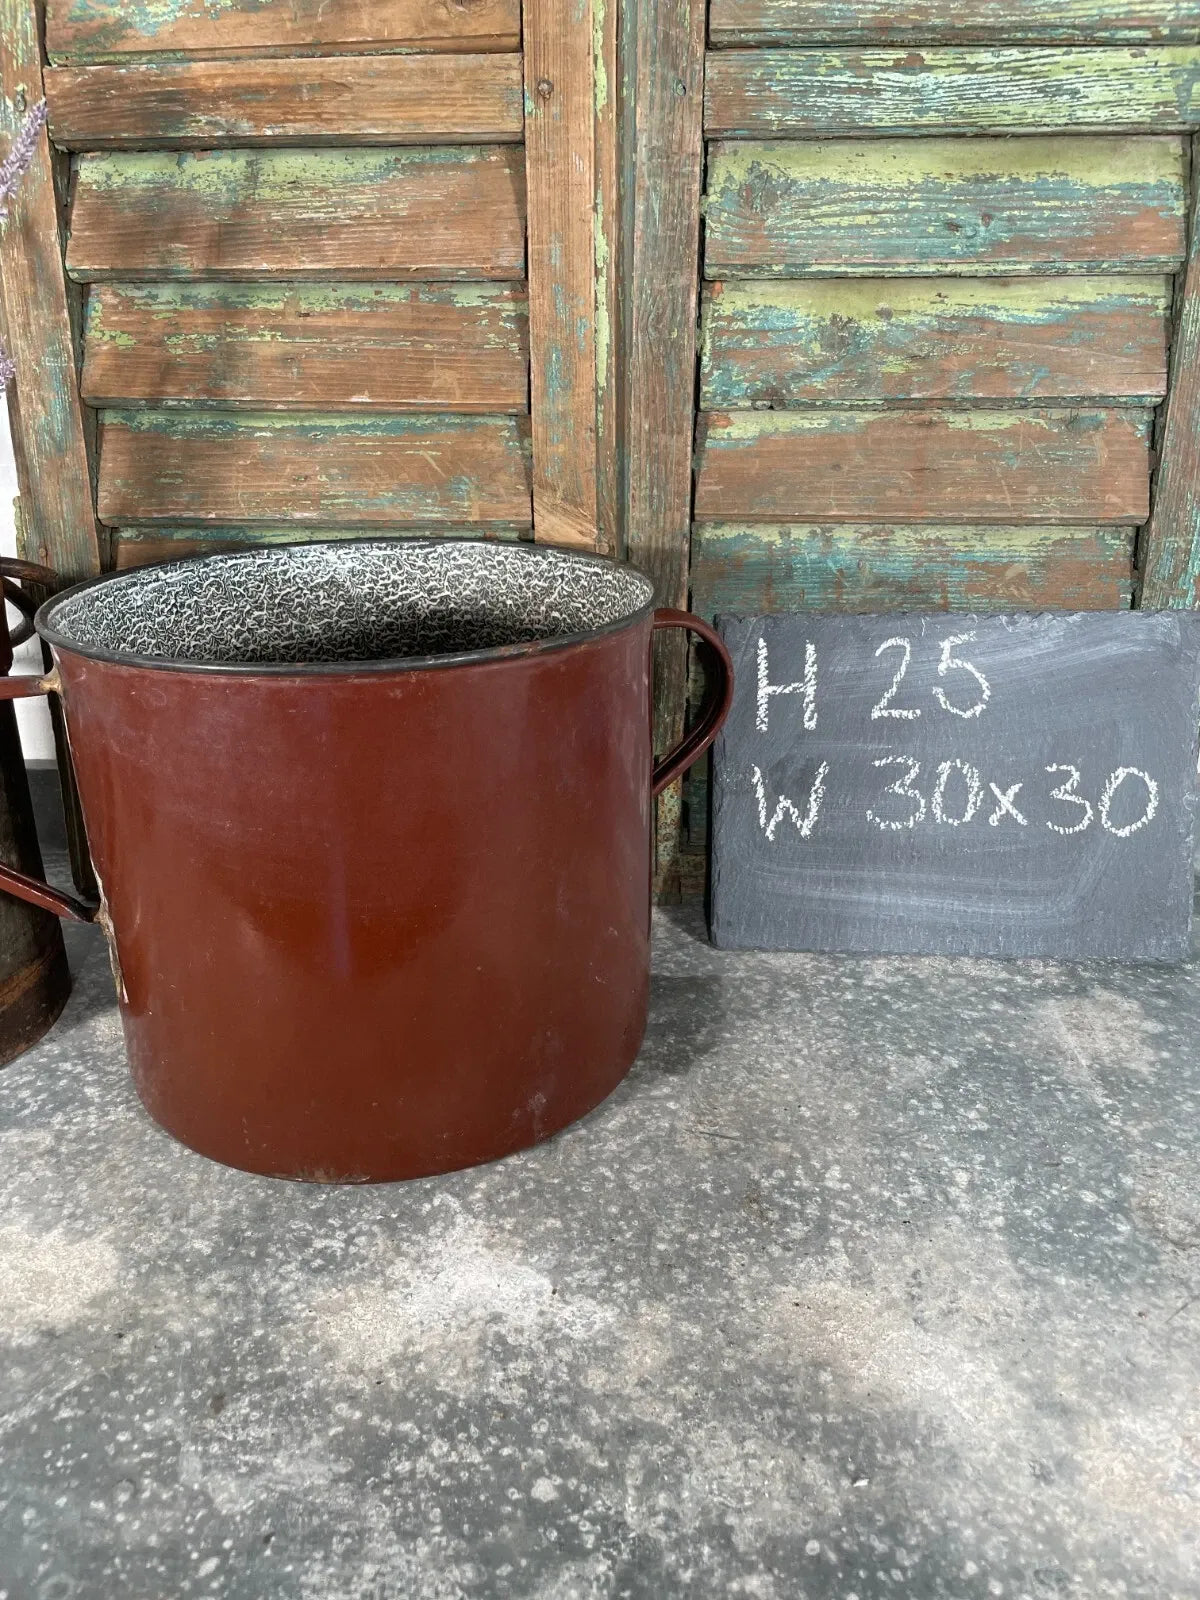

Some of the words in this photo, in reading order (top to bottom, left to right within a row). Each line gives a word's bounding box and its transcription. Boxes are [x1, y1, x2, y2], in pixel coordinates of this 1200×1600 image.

[755, 636, 818, 733] H
[871, 630, 992, 720] 25
[751, 761, 829, 841] W
